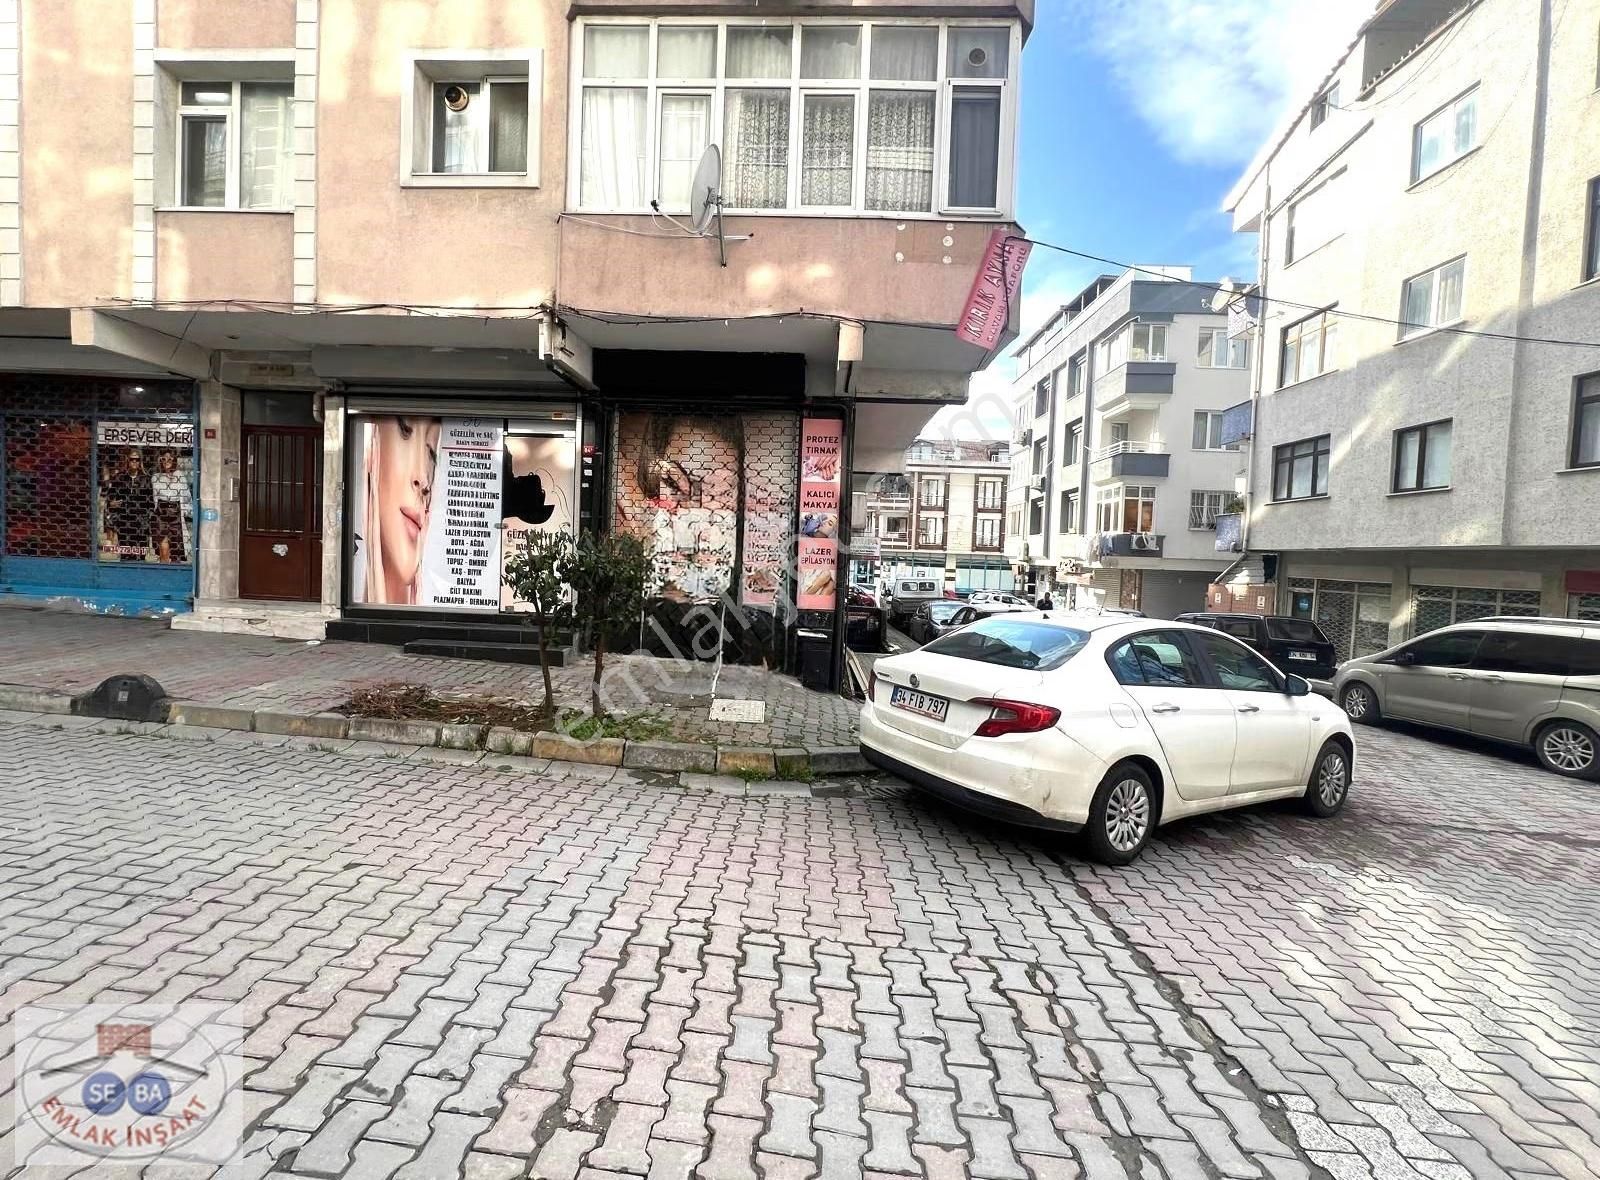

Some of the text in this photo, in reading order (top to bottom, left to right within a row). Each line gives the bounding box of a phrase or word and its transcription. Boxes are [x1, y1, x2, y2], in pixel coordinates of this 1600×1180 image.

[964, 242, 1014, 338] KIRIK AYNA
[806, 435, 839, 444] PROTEZ
[806, 446, 838, 454] TIRNAK
[806, 490, 835, 498] KALICI
[803, 501, 838, 509] MAKYAJ
[445, 529, 491, 538] LAZER EPİLASYON
[451, 538, 464, 546] BOYA
[470, 539, 484, 547] AĞDA
[446, 548, 468, 556] MAKYAJ
[805, 547, 832, 556] LAZER
[447, 558, 464, 566] TOPUZ
[468, 559, 487, 567] OMBRE
[801, 555, 835, 565] EPİLASYON
[451, 567, 462, 576] KAŞ
[467, 568, 482, 576] BIYIK
[450, 586, 482, 596] CİLT BAKIMI
[433, 595, 465, 604] PLAZMAPEN
[469, 598, 498, 607] DERMAPEN
[897, 690, 906, 704] 34
[909, 693, 925, 709] FIB
[927, 698, 945, 714] 797
